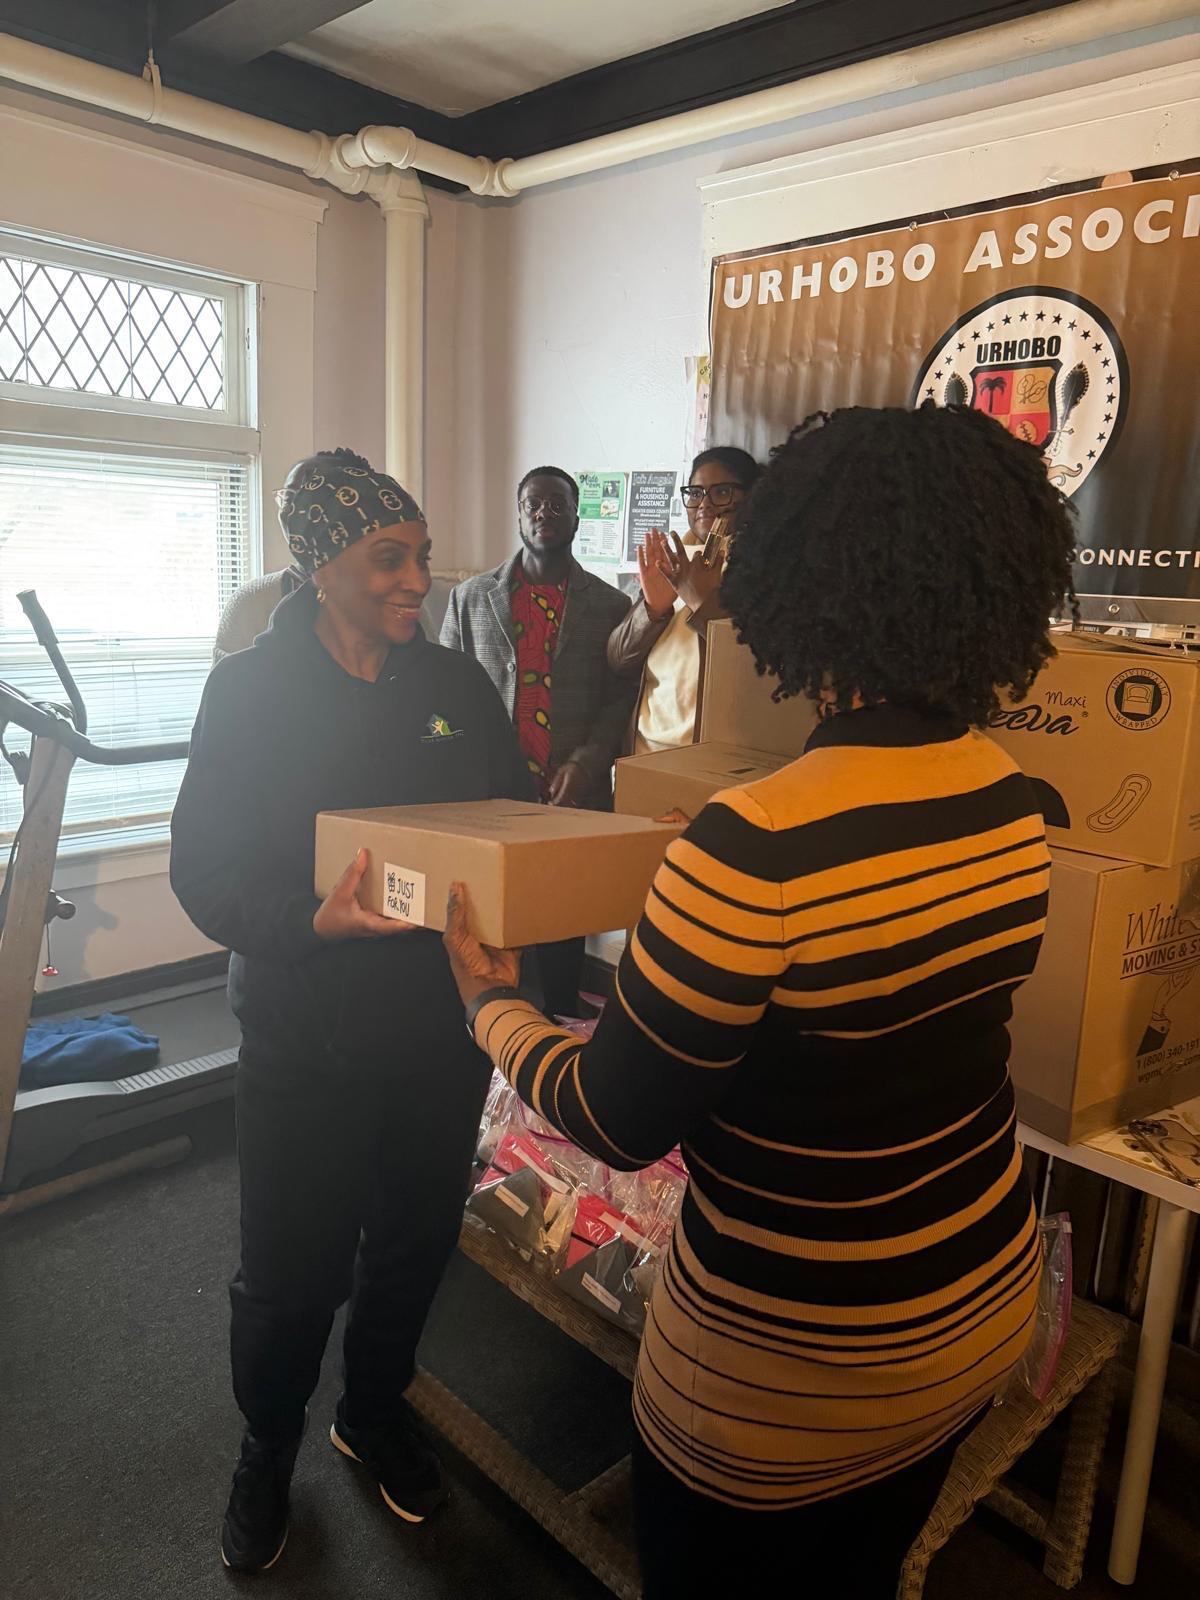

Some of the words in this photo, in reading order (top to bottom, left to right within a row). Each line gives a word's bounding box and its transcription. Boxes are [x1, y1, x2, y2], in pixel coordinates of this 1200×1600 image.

[723, 243, 935, 309] URHOBO
[963, 194, 1200, 273] ASSOCI
[976, 335, 1062, 365] URHOBO
[1067, 549, 1200, 568] ONNECTI
[1110, 669, 1169, 697] INDIVIDUALLY
[1045, 691, 1087, 708] Maxi
[1115, 712, 1158, 729] WRAPPED
[397, 878, 414, 899] JUST
[387, 895, 399, 911] FOR
[399, 899, 410, 917] YOU
[1122, 945, 1177, 975] MOVING
[1178, 942, 1187, 957] &
